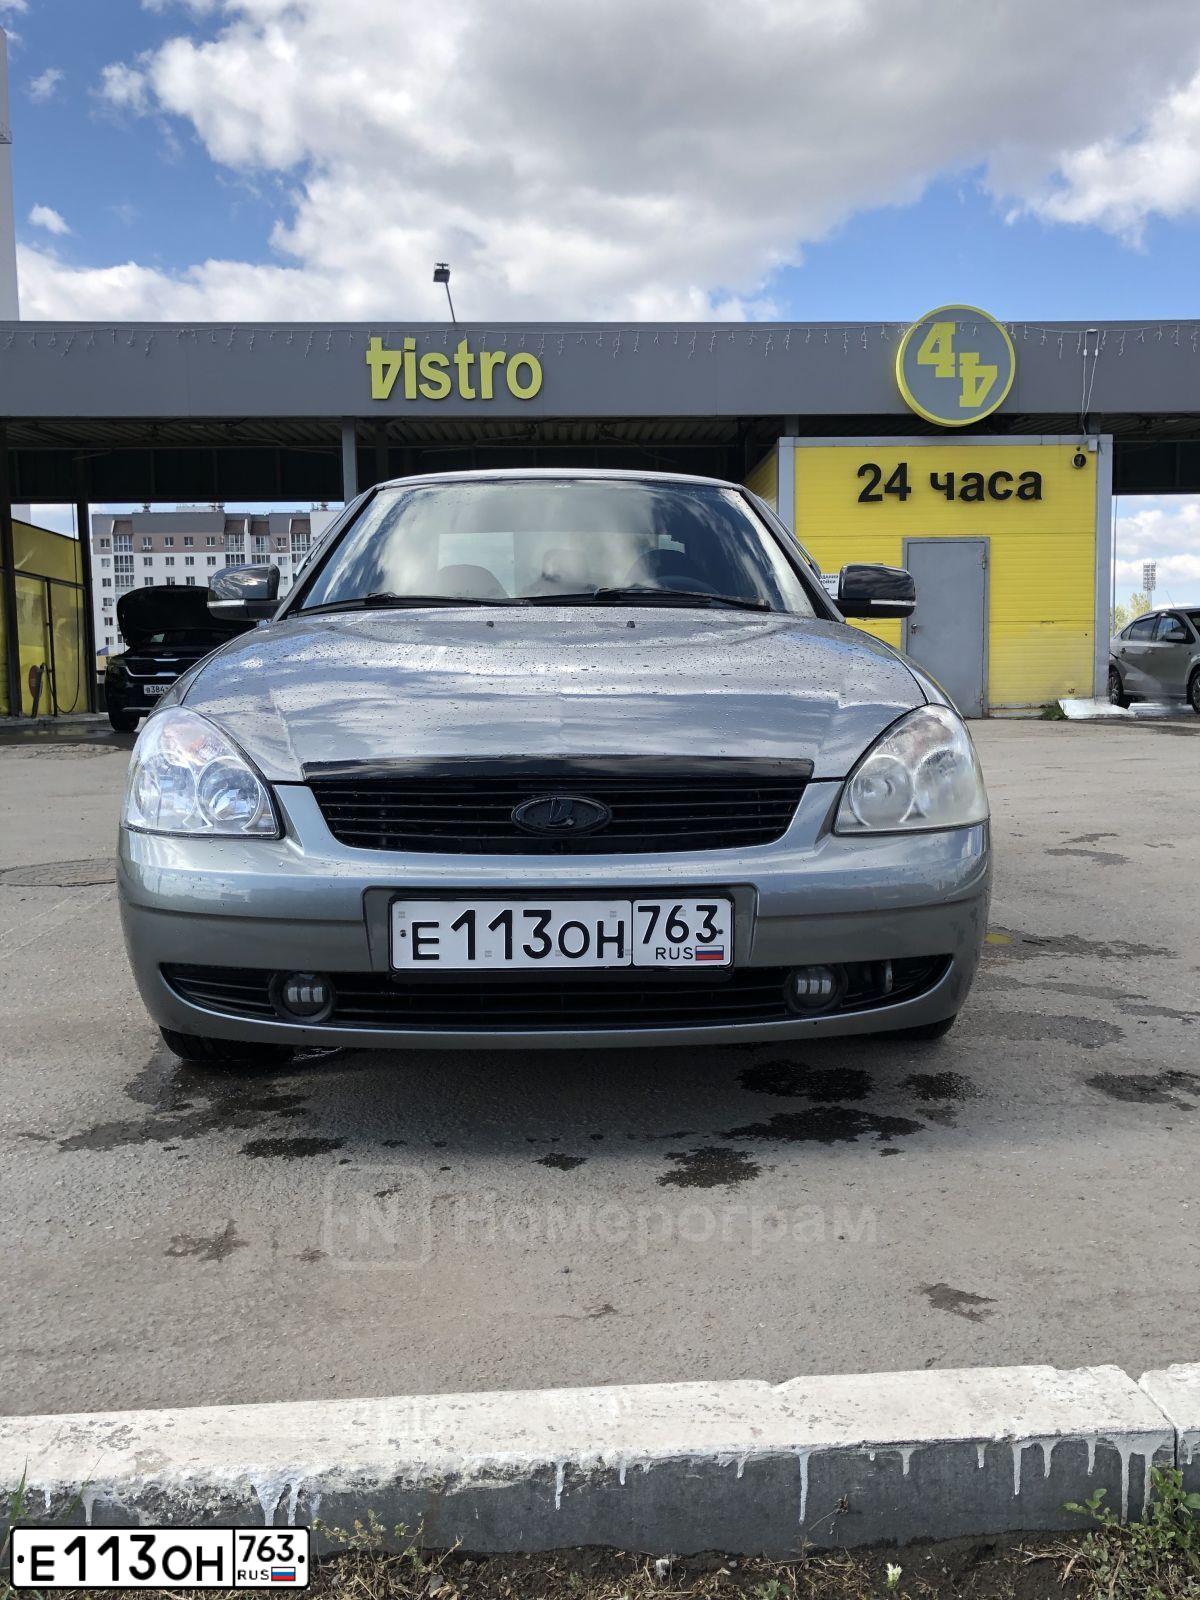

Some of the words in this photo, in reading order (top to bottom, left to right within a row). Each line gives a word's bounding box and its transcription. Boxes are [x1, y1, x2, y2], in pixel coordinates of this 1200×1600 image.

[857, 462, 911, 503] 24
[930, 470, 1042, 501] часа
[411, 909, 625, 960] Е113ОН
[637, 904, 718, 944] 763
[655, 946, 694, 960] RUS
